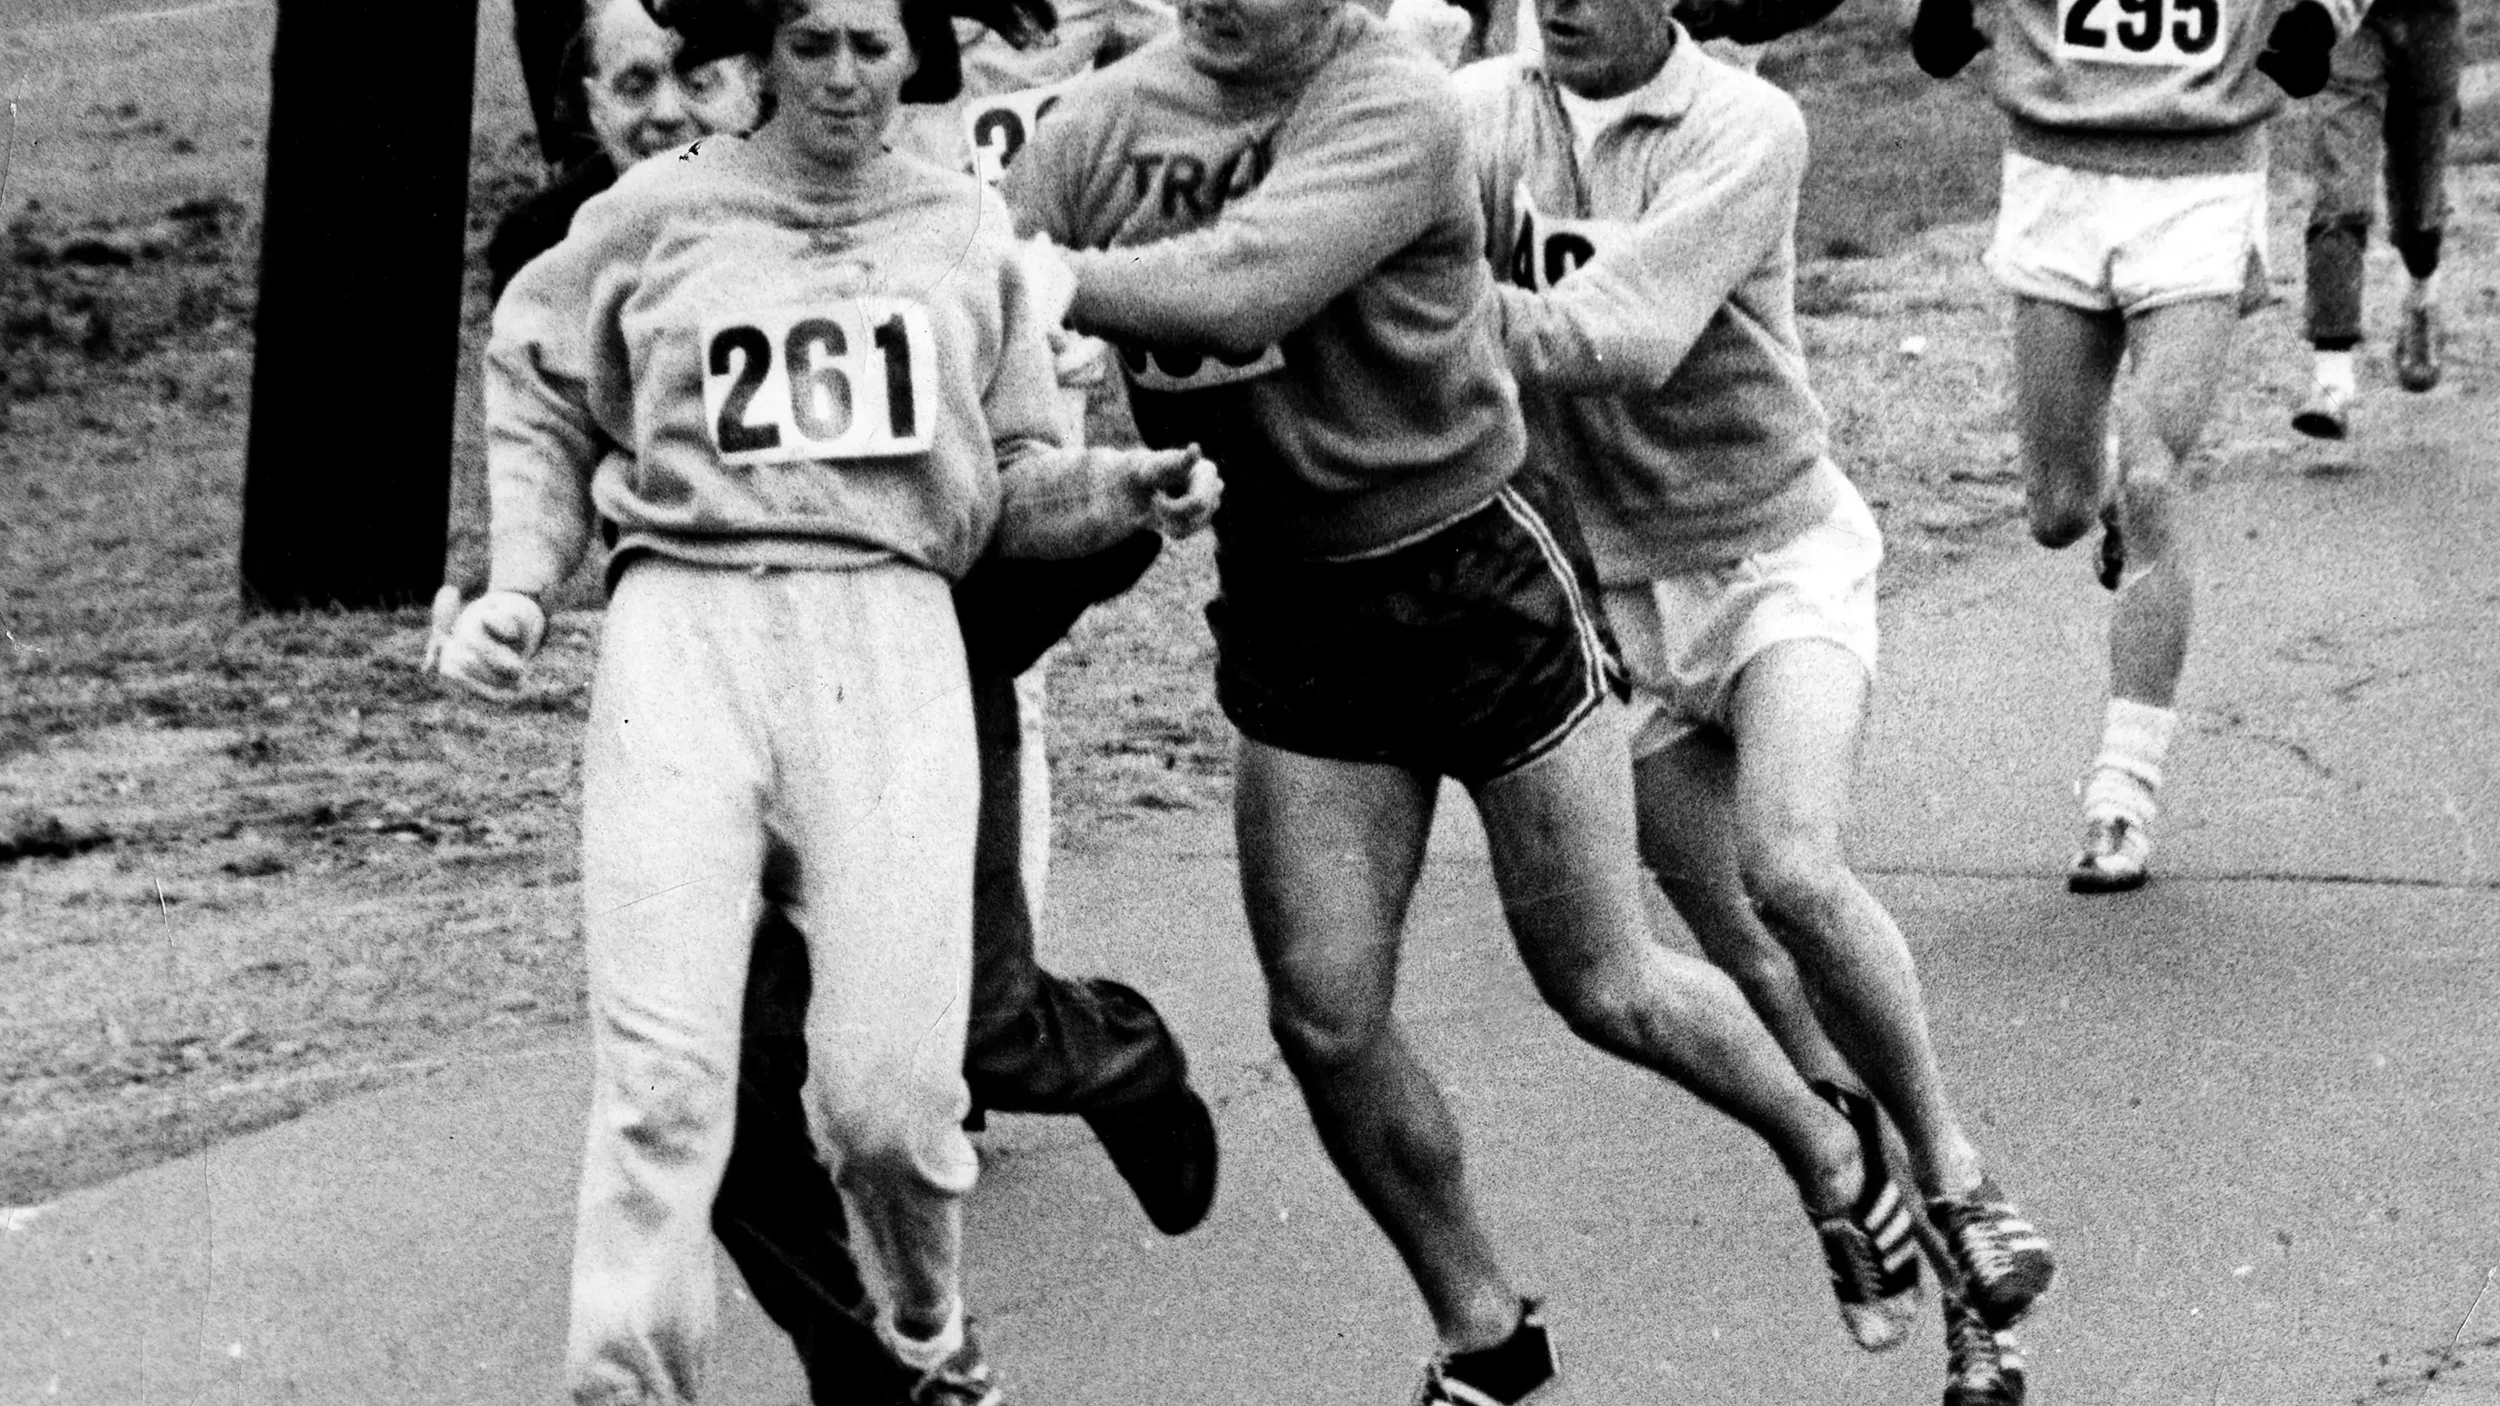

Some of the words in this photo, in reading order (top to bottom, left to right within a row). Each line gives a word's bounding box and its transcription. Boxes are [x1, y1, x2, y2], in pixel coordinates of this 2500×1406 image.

[2064, 0, 2218, 54] 295
[1124, 133, 1272, 218] TRA
[708, 313, 916, 453] 261
